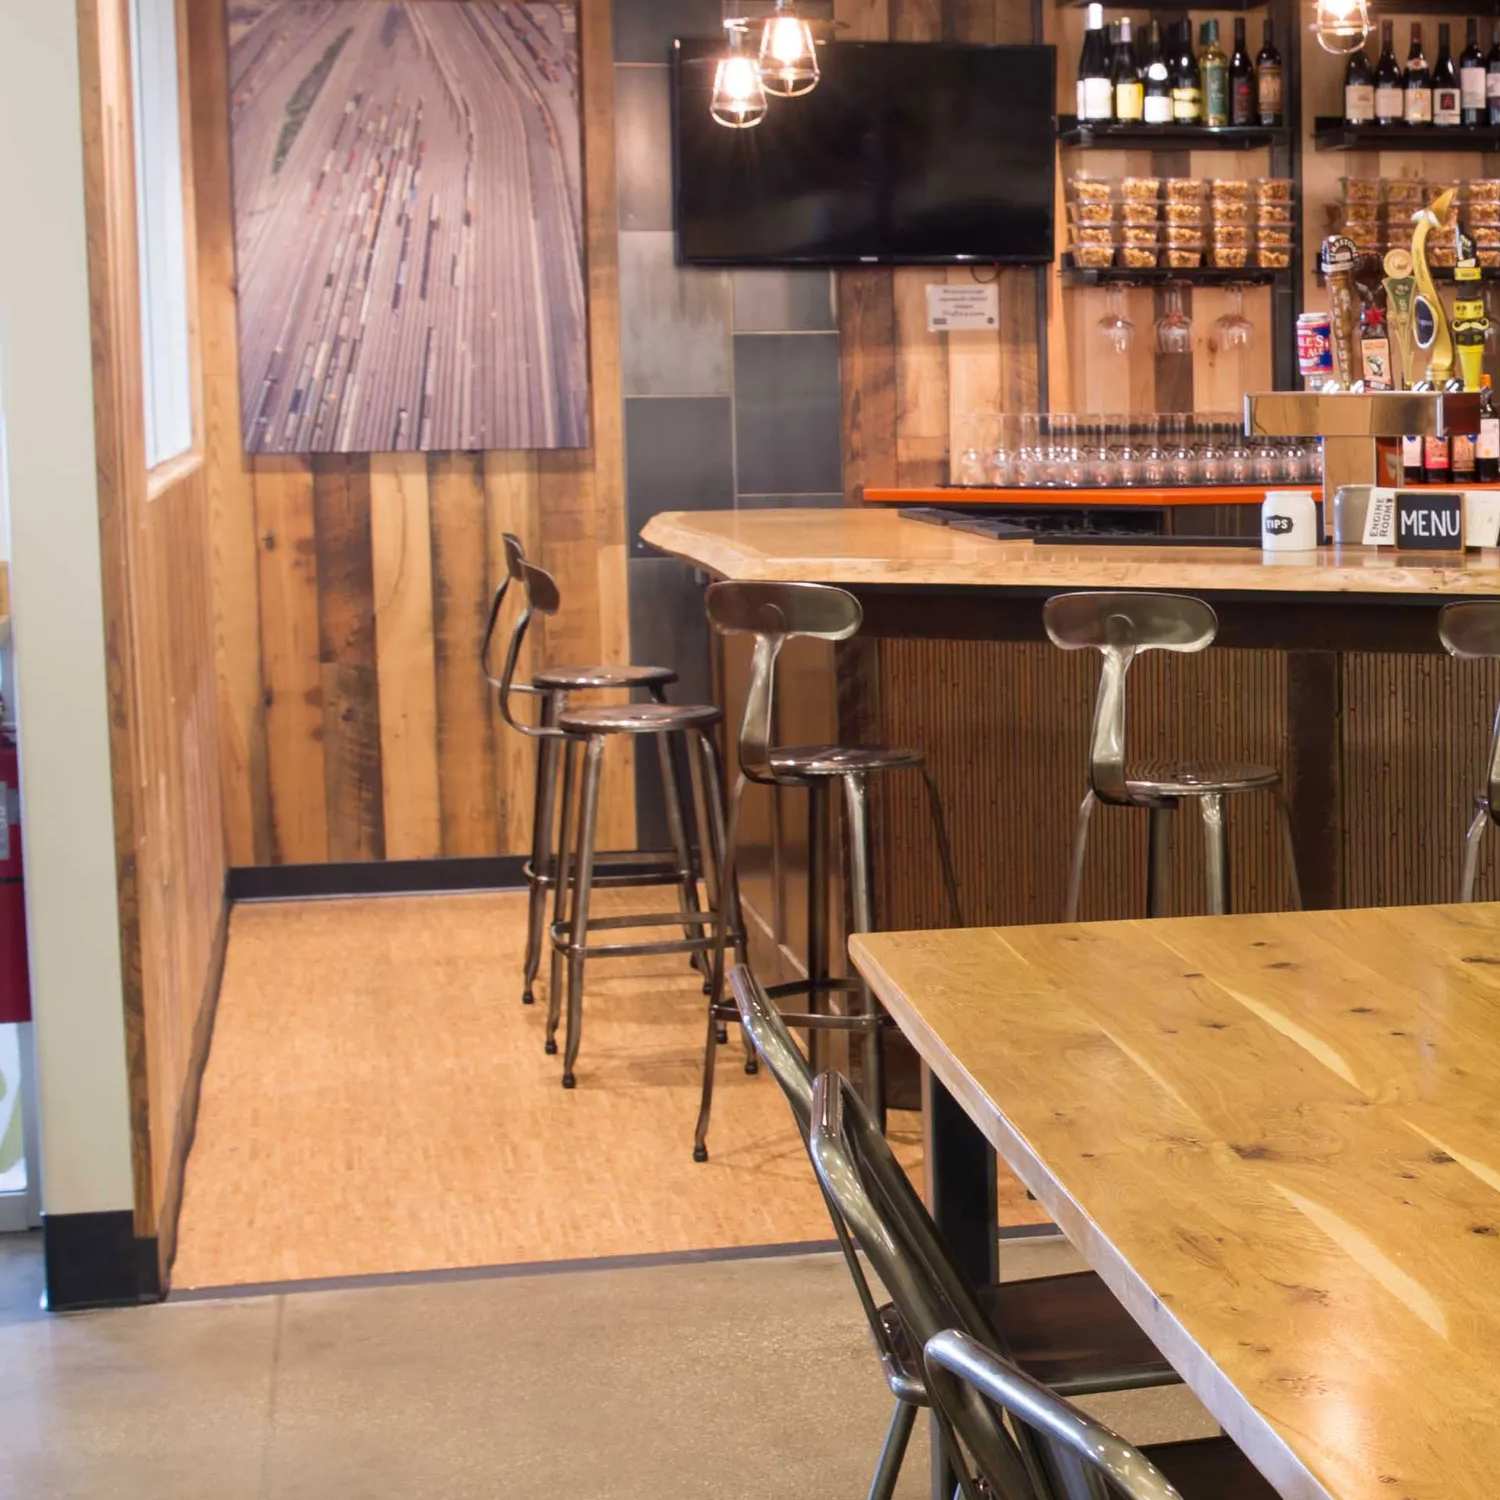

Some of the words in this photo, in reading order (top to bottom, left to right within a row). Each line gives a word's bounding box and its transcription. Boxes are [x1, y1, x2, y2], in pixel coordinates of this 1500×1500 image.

[1266, 519, 1289, 530] TIPS
[1369, 498, 1385, 538] ENGINE
[1379, 505, 1393, 538] ROOM
[1400, 509, 1460, 537] MENU
